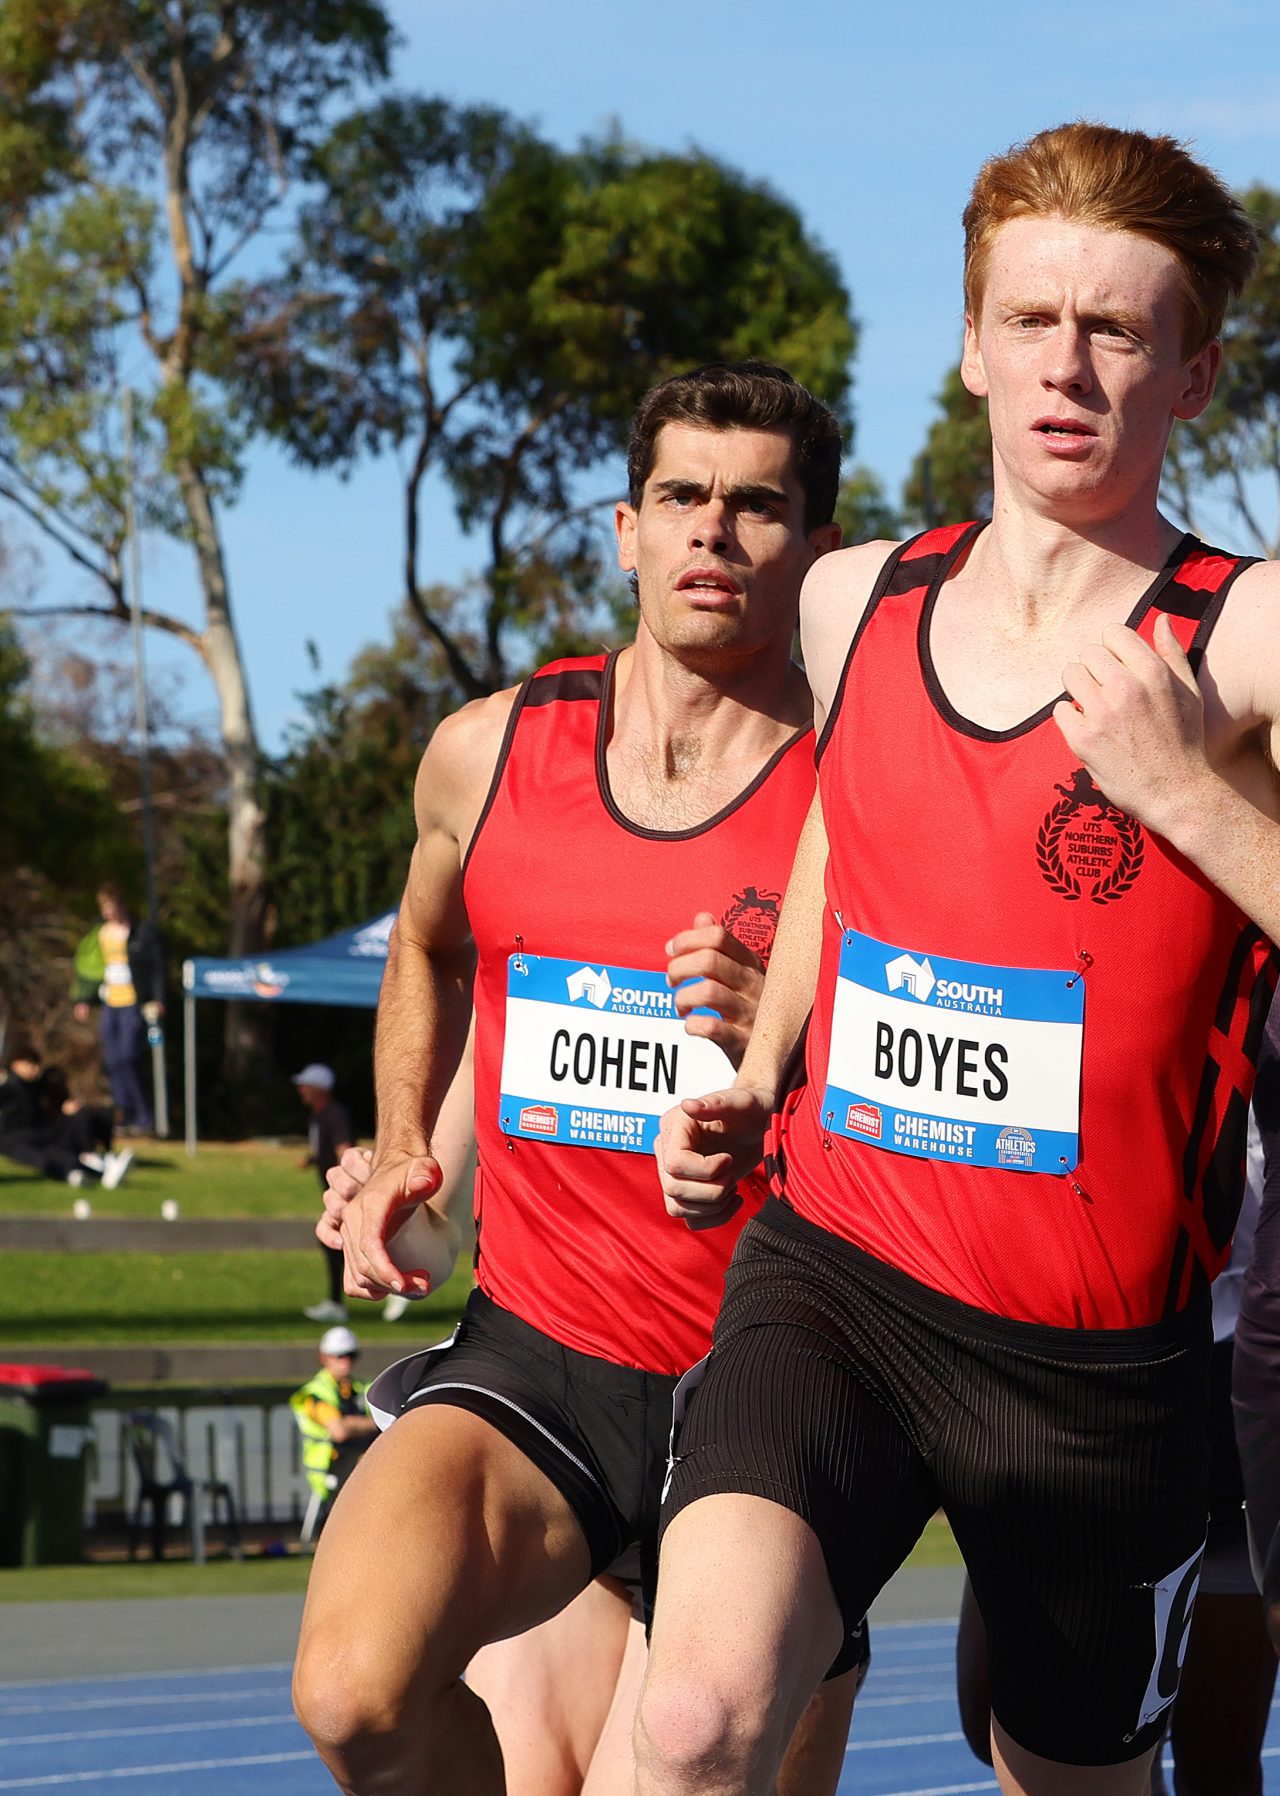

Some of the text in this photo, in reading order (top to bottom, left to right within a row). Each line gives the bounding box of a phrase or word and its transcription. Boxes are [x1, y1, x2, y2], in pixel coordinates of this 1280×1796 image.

[1083, 822, 1102, 832] UTS
[1065, 832, 1118, 846] NORTHERN
[1068, 843, 1113, 857] SUBURBS
[1066, 854, 1112, 868] ATHLETIC
[1075, 867, 1101, 878] CLUB
[611, 986, 673, 1009] SOUTH
[936, 979, 1003, 1007] SOUTH
[611, 1003, 672, 1018] AUSTRALIA
[936, 998, 1003, 1016] AUSTRALIA
[550, 1029, 679, 1095] COHEN
[874, 1020, 1009, 1102] BOYES
[522, 1112, 556, 1126] CHEMIST
[570, 1109, 646, 1135] CHEMIST
[850, 1109, 880, 1128] CHEMIST
[569, 1129, 643, 1146] WAREHOUSE
[894, 1113, 977, 1146] CHEMIST
[893, 1134, 973, 1158] WAREHOUSE
[995, 1138, 1036, 1154] ATHLETICS
